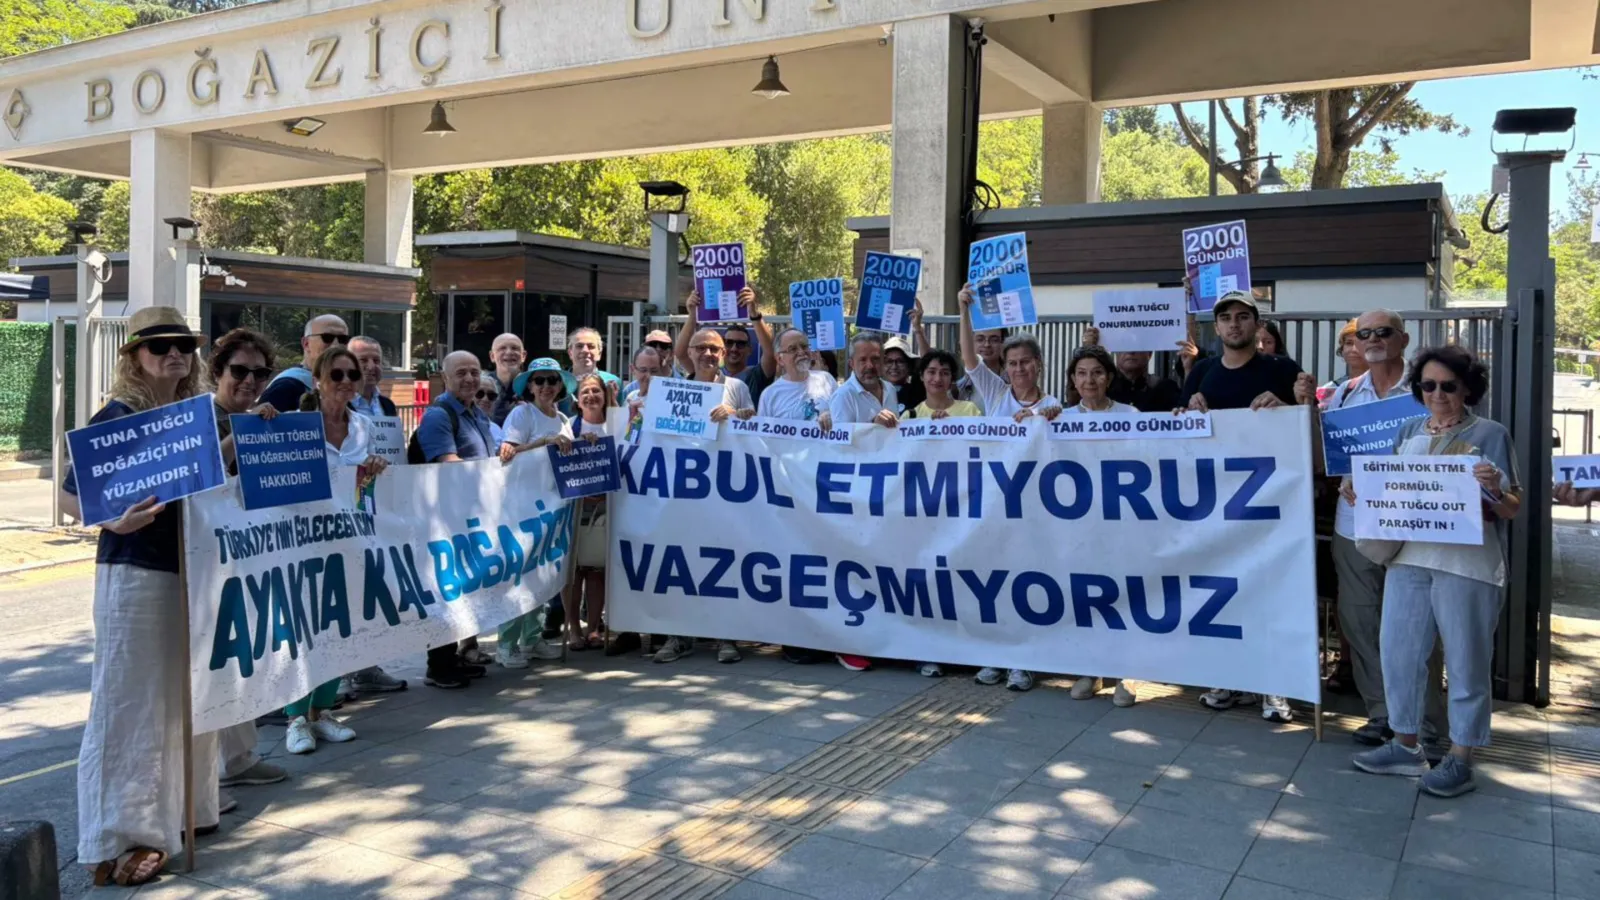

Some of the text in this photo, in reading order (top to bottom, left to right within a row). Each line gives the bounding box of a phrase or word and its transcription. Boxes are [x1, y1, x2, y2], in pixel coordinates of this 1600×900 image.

[84, 0, 836, 123] BOĞAZİÇİ UN
[1186, 226, 1243, 252] 2000
[695, 246, 742, 267] 2000
[971, 238, 1023, 266] 2000
[1187, 247, 1245, 265] GÜNDÜR
[695, 265, 744, 278] GÜNDÜR
[867, 255, 919, 280] 2000
[969, 262, 1026, 280] GÜNDÜR
[792, 279, 840, 298] 2000
[863, 275, 916, 292] GÜNDÜR
[792, 296, 841, 309] GÜNDÜR
[1108, 302, 1170, 313] TUNA TUĞCU
[1099, 319, 1174, 329] ONURUMUZDUR
[666, 389, 702, 407] AYAKTA
[671, 404, 691, 418] KAL
[90, 411, 194, 450] TUNA TUĞCU
[732, 420, 849, 441] TAM 2.000 GÜNDÜR
[900, 423, 1027, 437] TAM 2.000 GÜNDÜR
[1051, 417, 1206, 433] TAM 2.000 GÜNDÜR
[1328, 427, 1359, 439] TUNA
[237, 428, 320, 445] MEZUNİYET TÖRENİ
[1342, 438, 1396, 454] YANINDA
[92, 434, 202, 478] BOĞAZİÇİ'NİN
[240, 447, 324, 465] TÜM ÖĞRENCİLERİN
[559, 458, 611, 473] BOĞAZİÇİ'NİN
[1363, 459, 1466, 473] EĞİTİMİ YOK ETME
[103, 462, 199, 501] YÜZAKIDIR !
[259, 471, 312, 489] HAKKIDIR!
[566, 475, 605, 488] YÜZAKIDIR
[617, 444, 1281, 521] KABUL ETMİYORUZ
[1384, 479, 1443, 492] FORMÜLÜ:
[1366, 498, 1466, 512] TUNA TUĞCU OUT
[1379, 517, 1455, 532] PARAŞÜT IN !
[214, 515, 295, 564] TÜRKİYE'NİN
[294, 508, 357, 548] GELECEĞİ
[619, 539, 1243, 640] VAZGEÇMİYORUZ
[209, 552, 351, 678] AYAKTA
[363, 543, 436, 627] KAL
